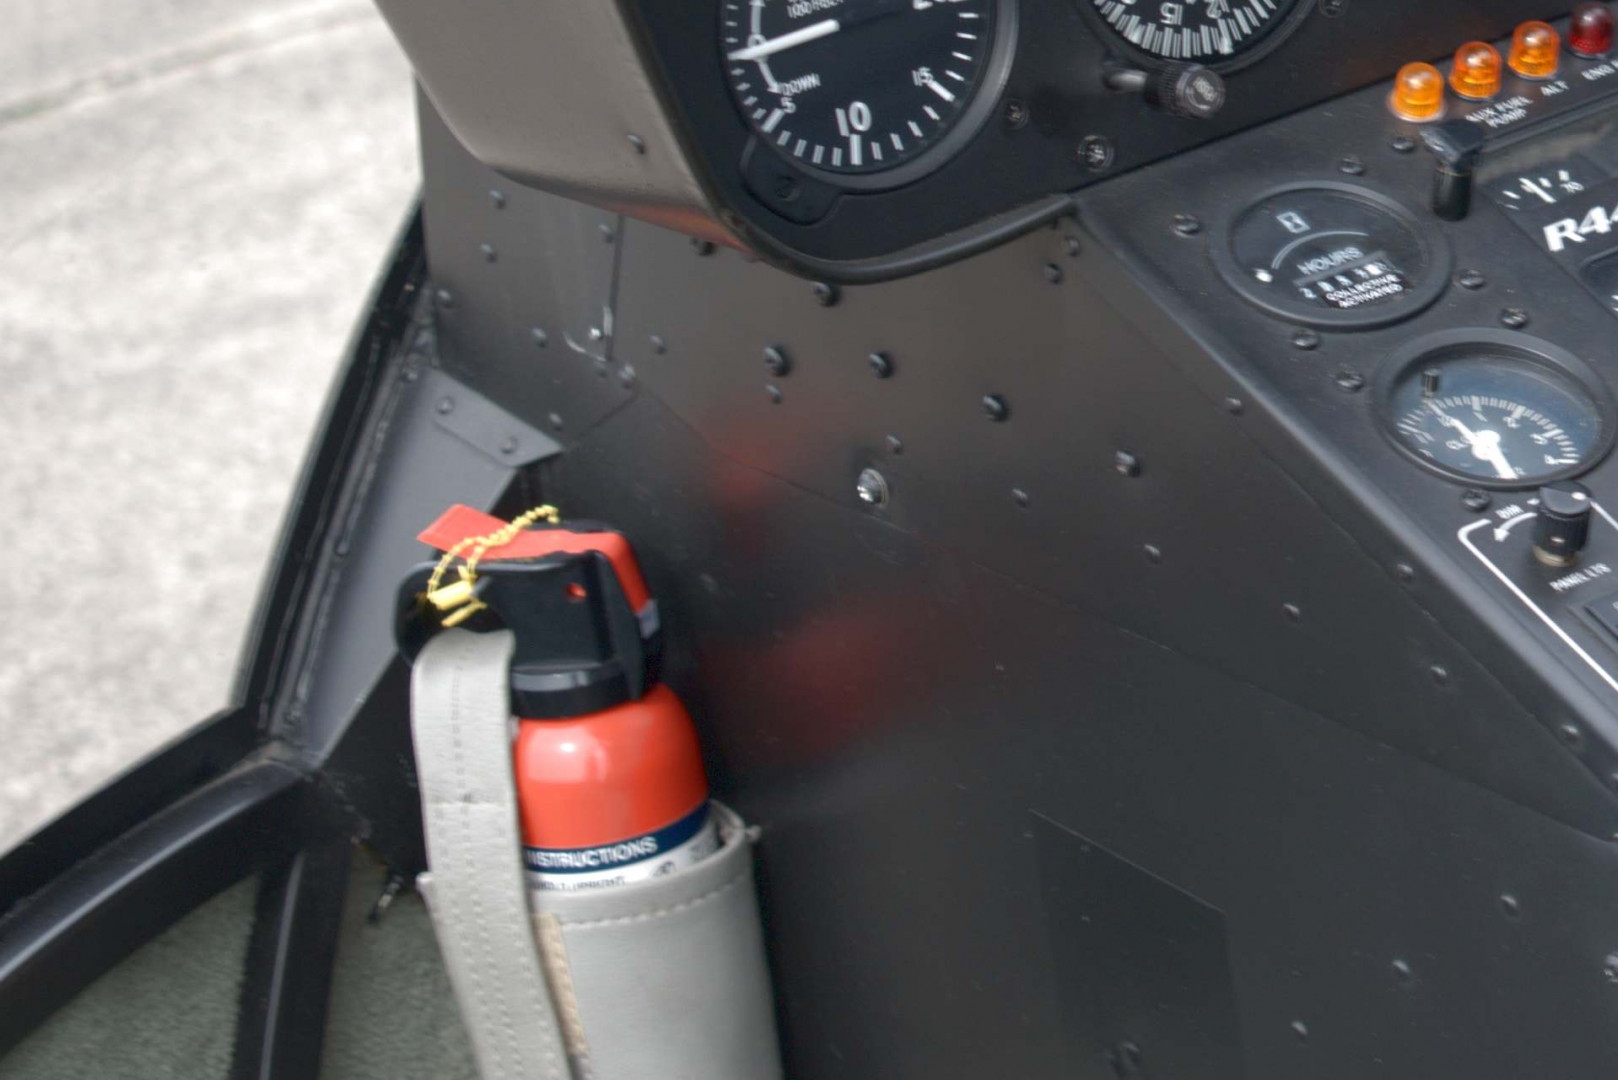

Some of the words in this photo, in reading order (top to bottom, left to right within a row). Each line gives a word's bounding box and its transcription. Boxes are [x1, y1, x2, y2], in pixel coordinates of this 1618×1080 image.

[1160, 2, 1183, 26] 15
[780, 72, 821, 95] DOWN
[912, 66, 934, 87] 15
[1581, 62, 1615, 82] ENG
[1539, 79, 1570, 96] ALT
[782, 97, 796, 114] 5
[1464, 105, 1498, 124] AUX
[1494, 94, 1534, 114] FUEL
[835, 101, 872, 137] 10
[1485, 107, 1528, 129] PUMP
[1297, 247, 1364, 275] HOURS
[1326, 274, 1401, 301] COLLECTIVE
[1338, 284, 1404, 308] ACTIVATED
[1495, 503, 1524, 520] DIM
[1549, 571, 1588, 593] PANEL
[1585, 562, 1613, 580] LTS
[527, 836, 659, 869] NSTRUCTIONS
